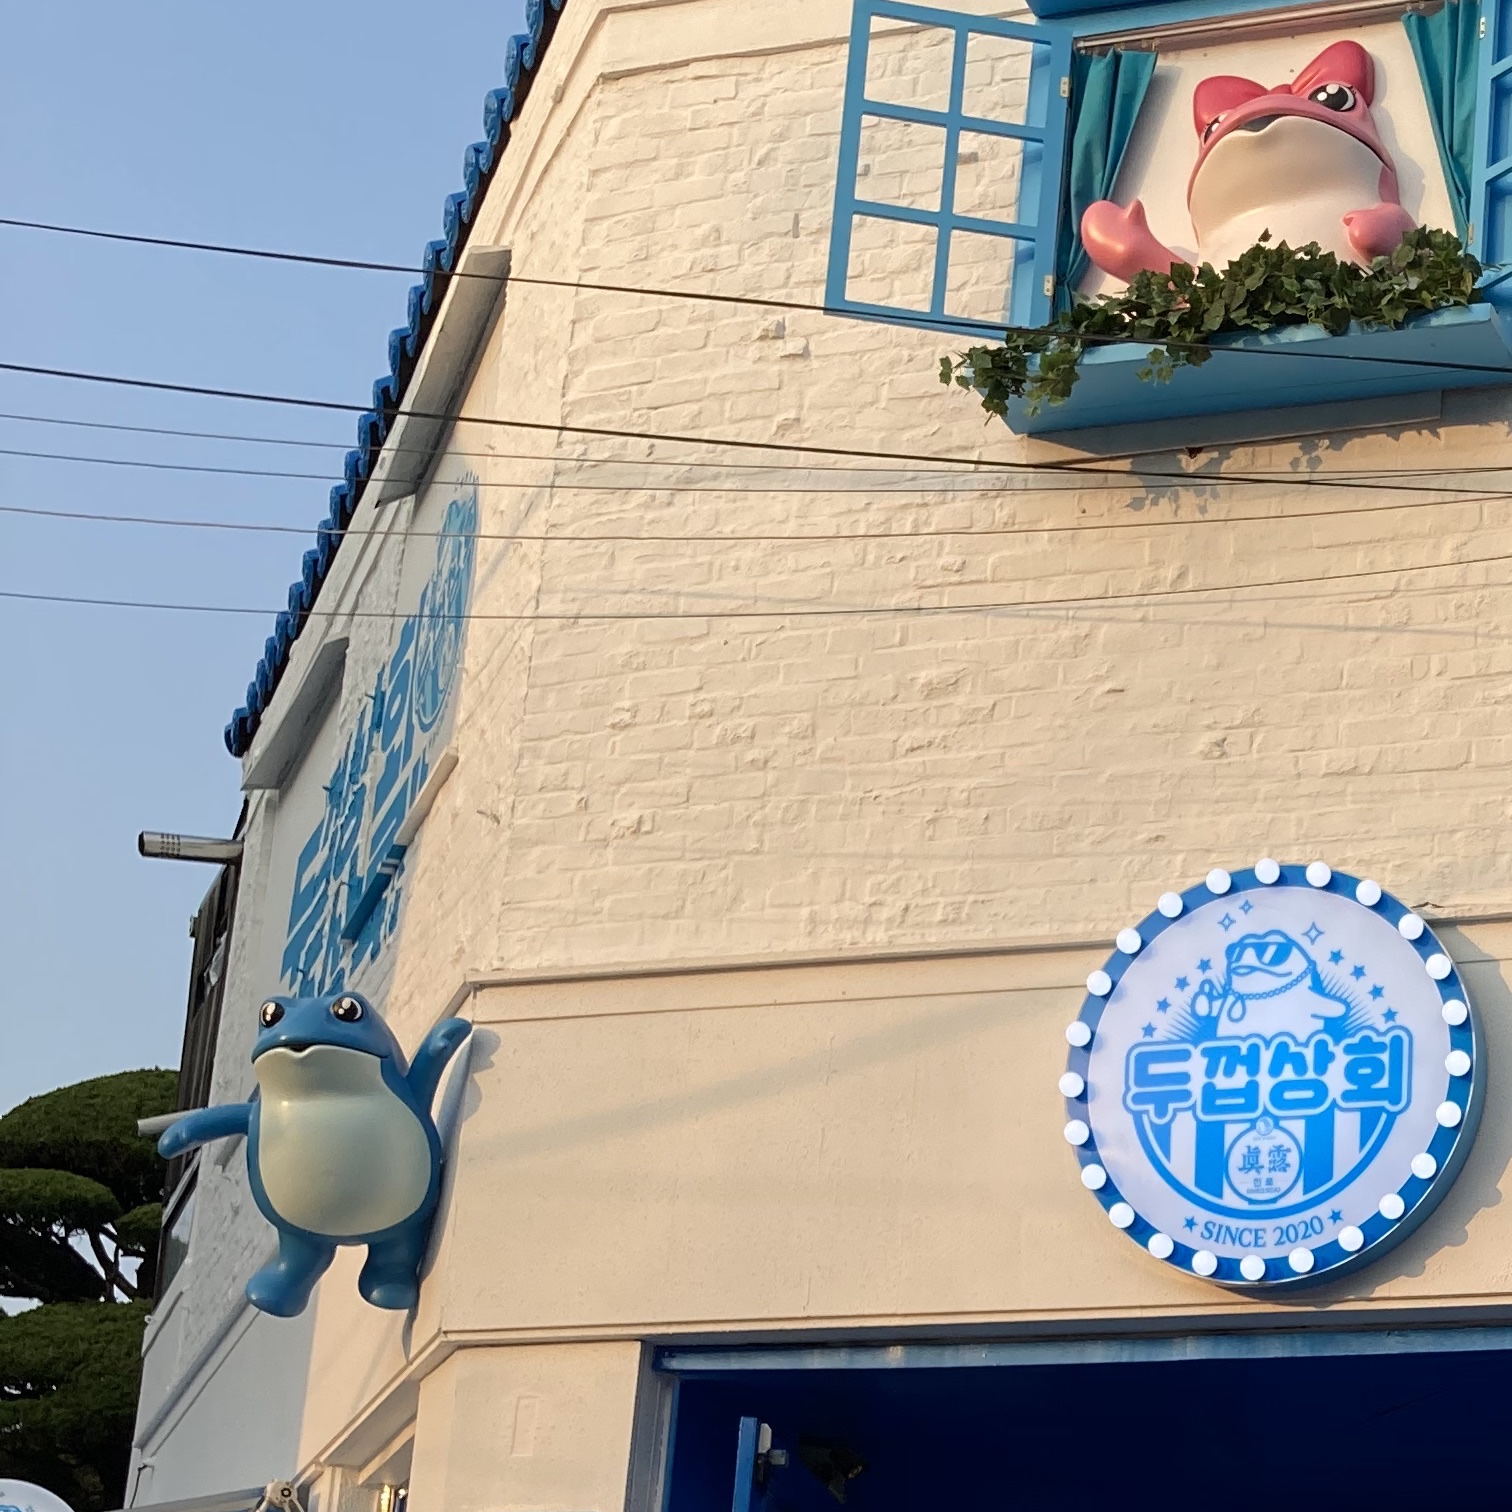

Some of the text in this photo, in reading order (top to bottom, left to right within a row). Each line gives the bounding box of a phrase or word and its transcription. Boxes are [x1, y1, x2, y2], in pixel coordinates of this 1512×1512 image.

[1130, 1034, 1402, 1118] 두껍상회
[1200, 1215, 1325, 1249] SINCE 2020
